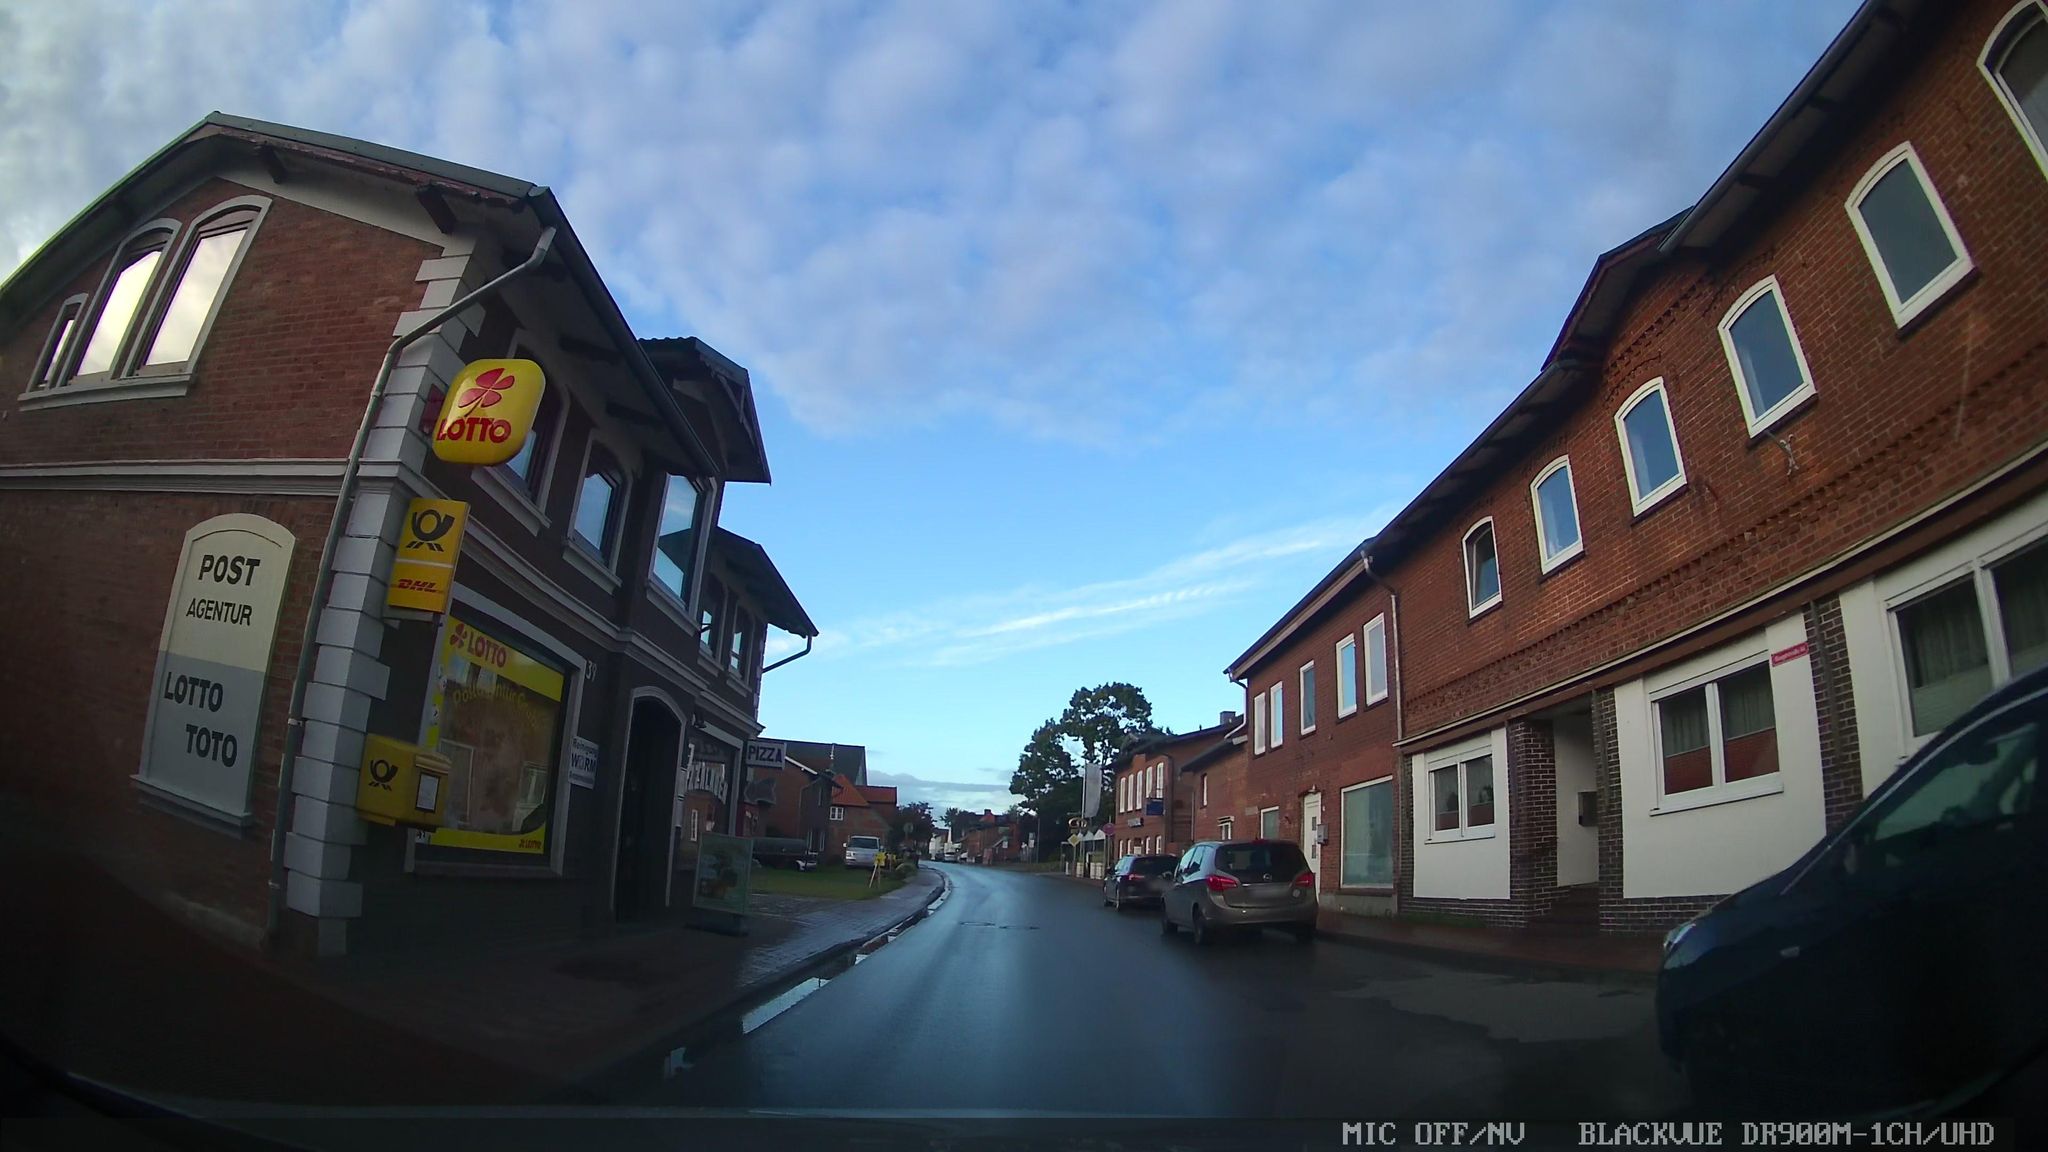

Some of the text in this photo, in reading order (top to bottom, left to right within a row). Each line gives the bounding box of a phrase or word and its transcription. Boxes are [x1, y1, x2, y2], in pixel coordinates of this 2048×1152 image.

[436, 416, 512, 444] LOTTO
[198, 554, 261, 586] POST
[398, 578, 438, 594] DHL
[186, 598, 253, 626] AGENTUR
[467, 630, 507, 668] LOTTO
[164, 671, 224, 713] LOTTO
[186, 723, 238, 768] TOTO
[748, 744, 783, 763] PIZZA
